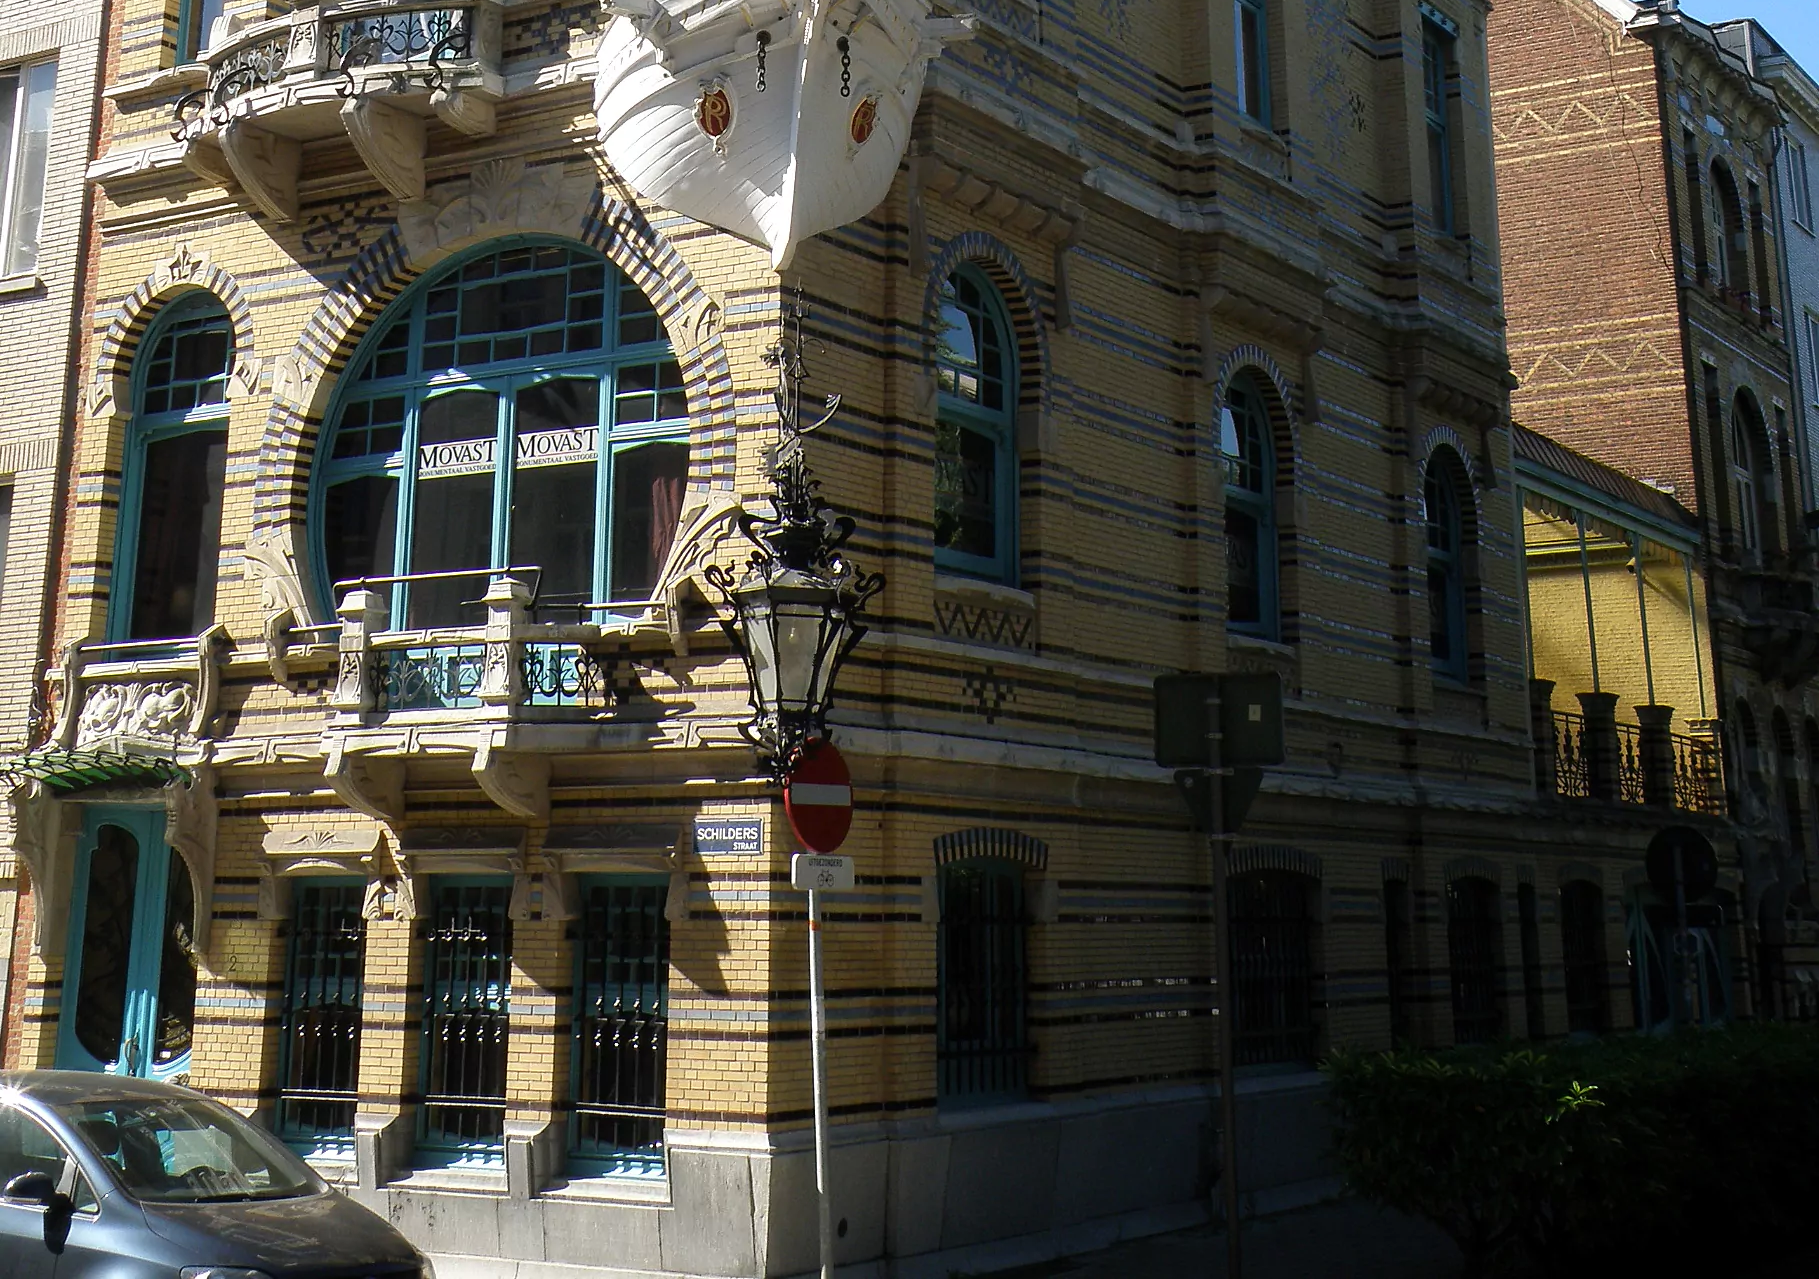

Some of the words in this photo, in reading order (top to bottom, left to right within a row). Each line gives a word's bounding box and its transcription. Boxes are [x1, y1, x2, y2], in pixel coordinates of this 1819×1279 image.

[516, 428, 599, 459] MOVAST
[418, 439, 498, 470] MOVAST
[565, 452, 599, 462] VASTGOED
[465, 463, 497, 473] VASTGOED
[697, 827, 759, 840] SCHILDERS
[732, 841, 758, 851] STRAAT
[228, 955, 238, 972] 2
